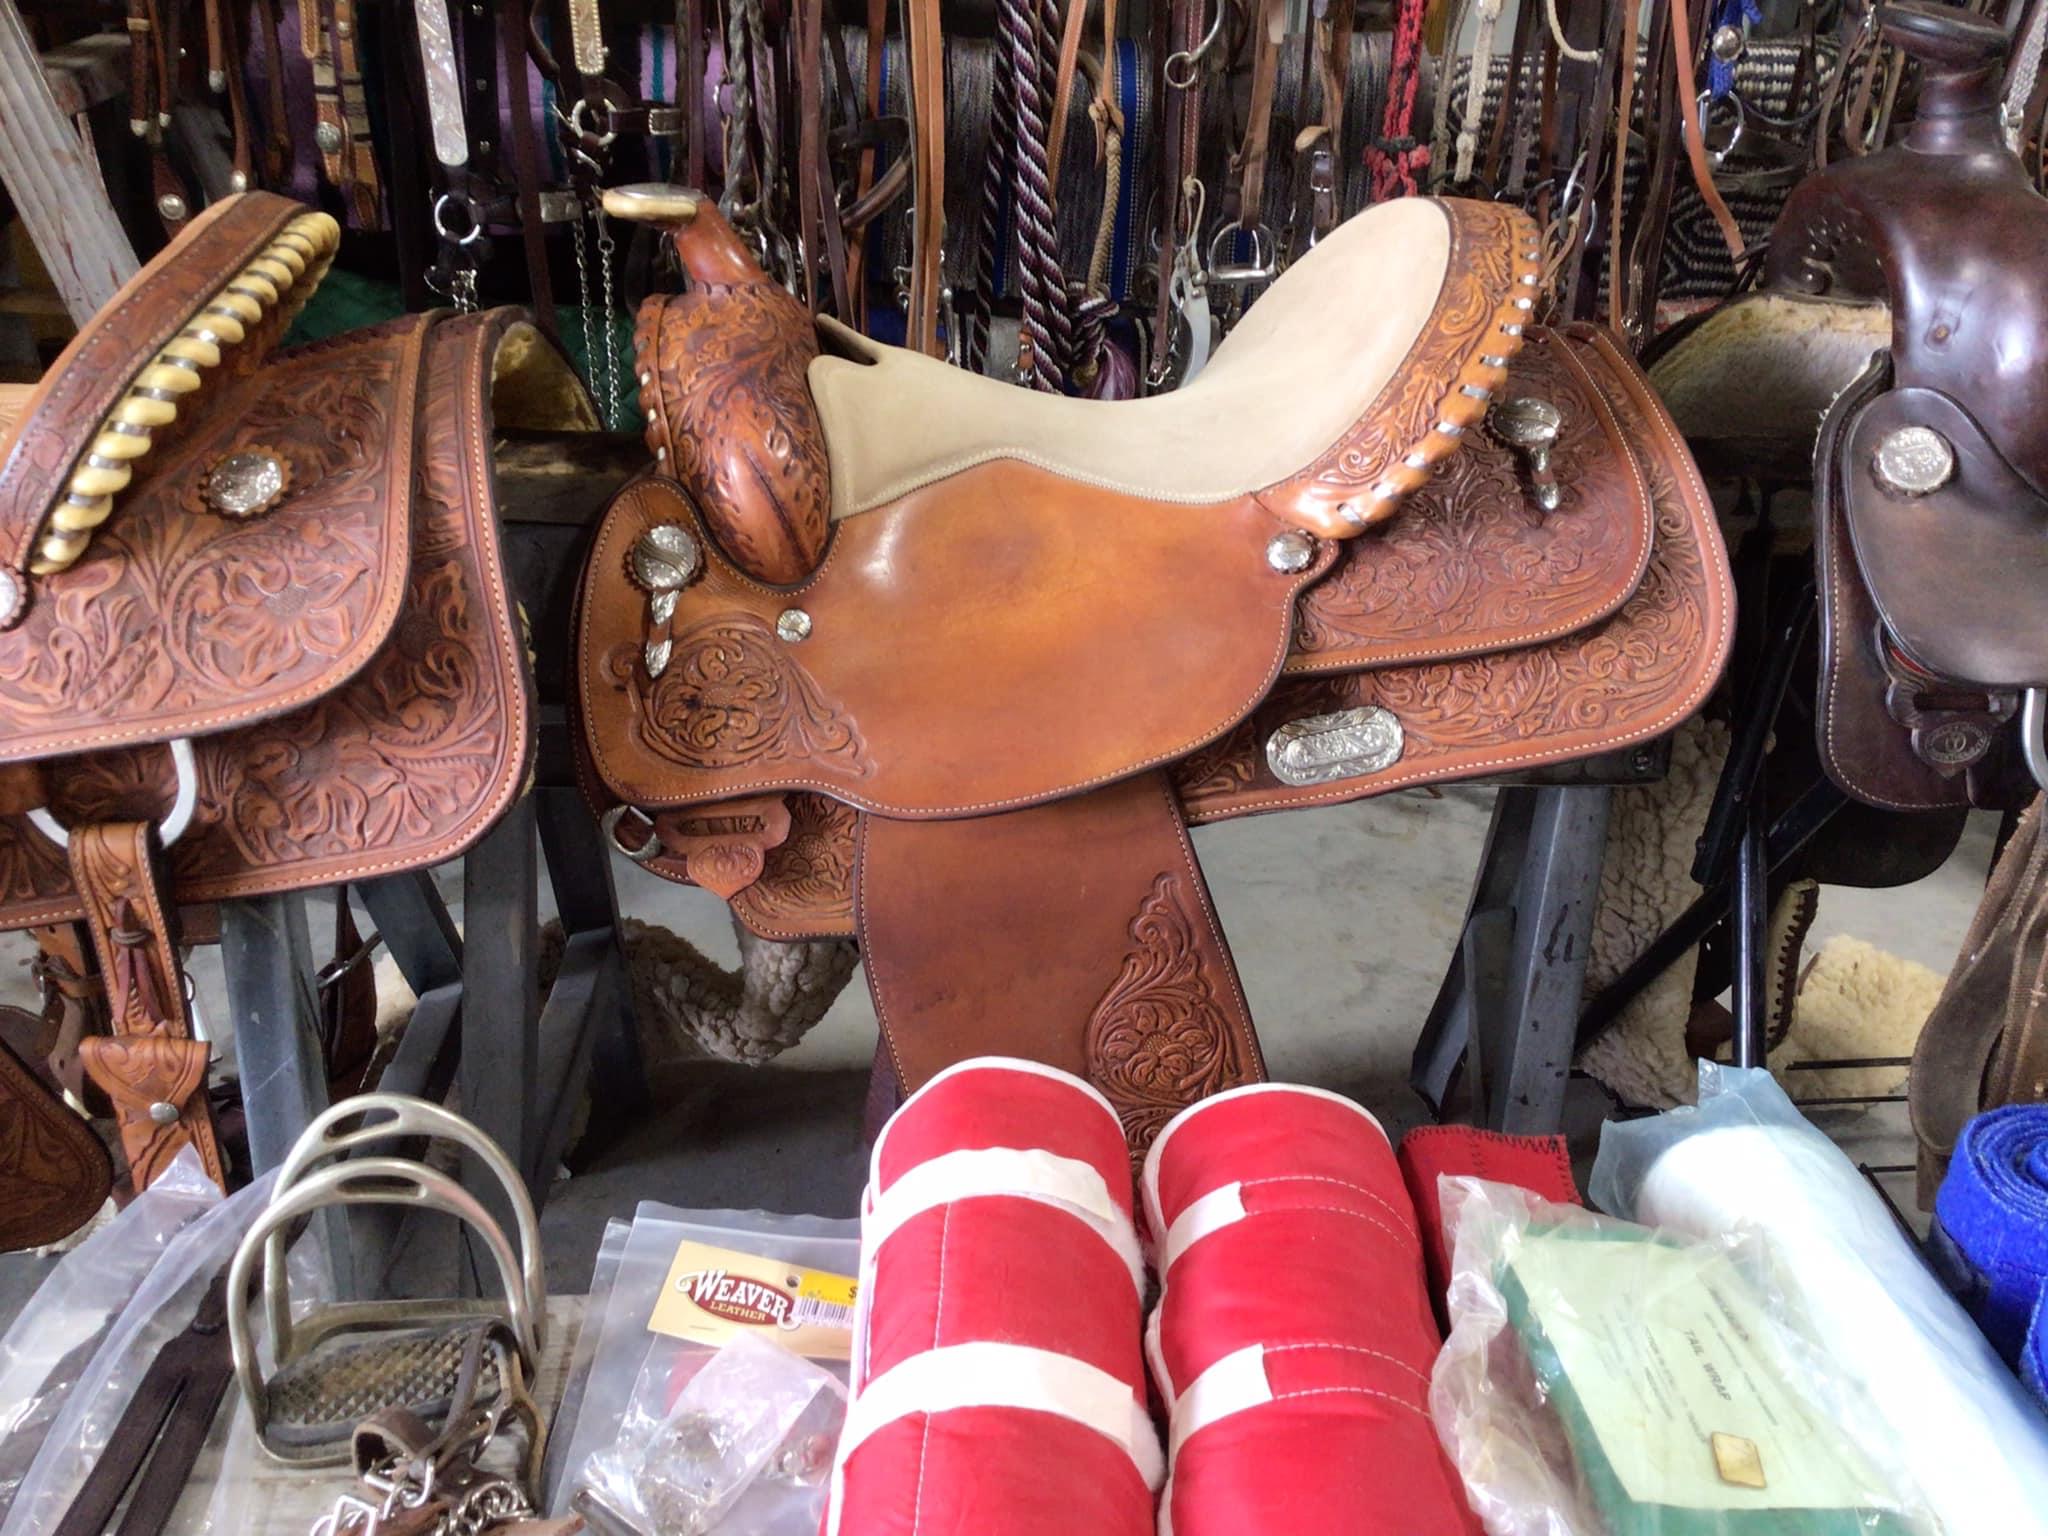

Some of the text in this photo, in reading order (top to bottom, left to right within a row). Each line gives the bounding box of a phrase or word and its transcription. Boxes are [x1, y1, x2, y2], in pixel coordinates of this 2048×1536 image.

[675, 1270, 801, 1330] WEAVER
[711, 1302, 766, 1321] LEATHER
[1683, 1329, 1705, 1356] TAIL
[1703, 1363, 1732, 1401] WRAP
